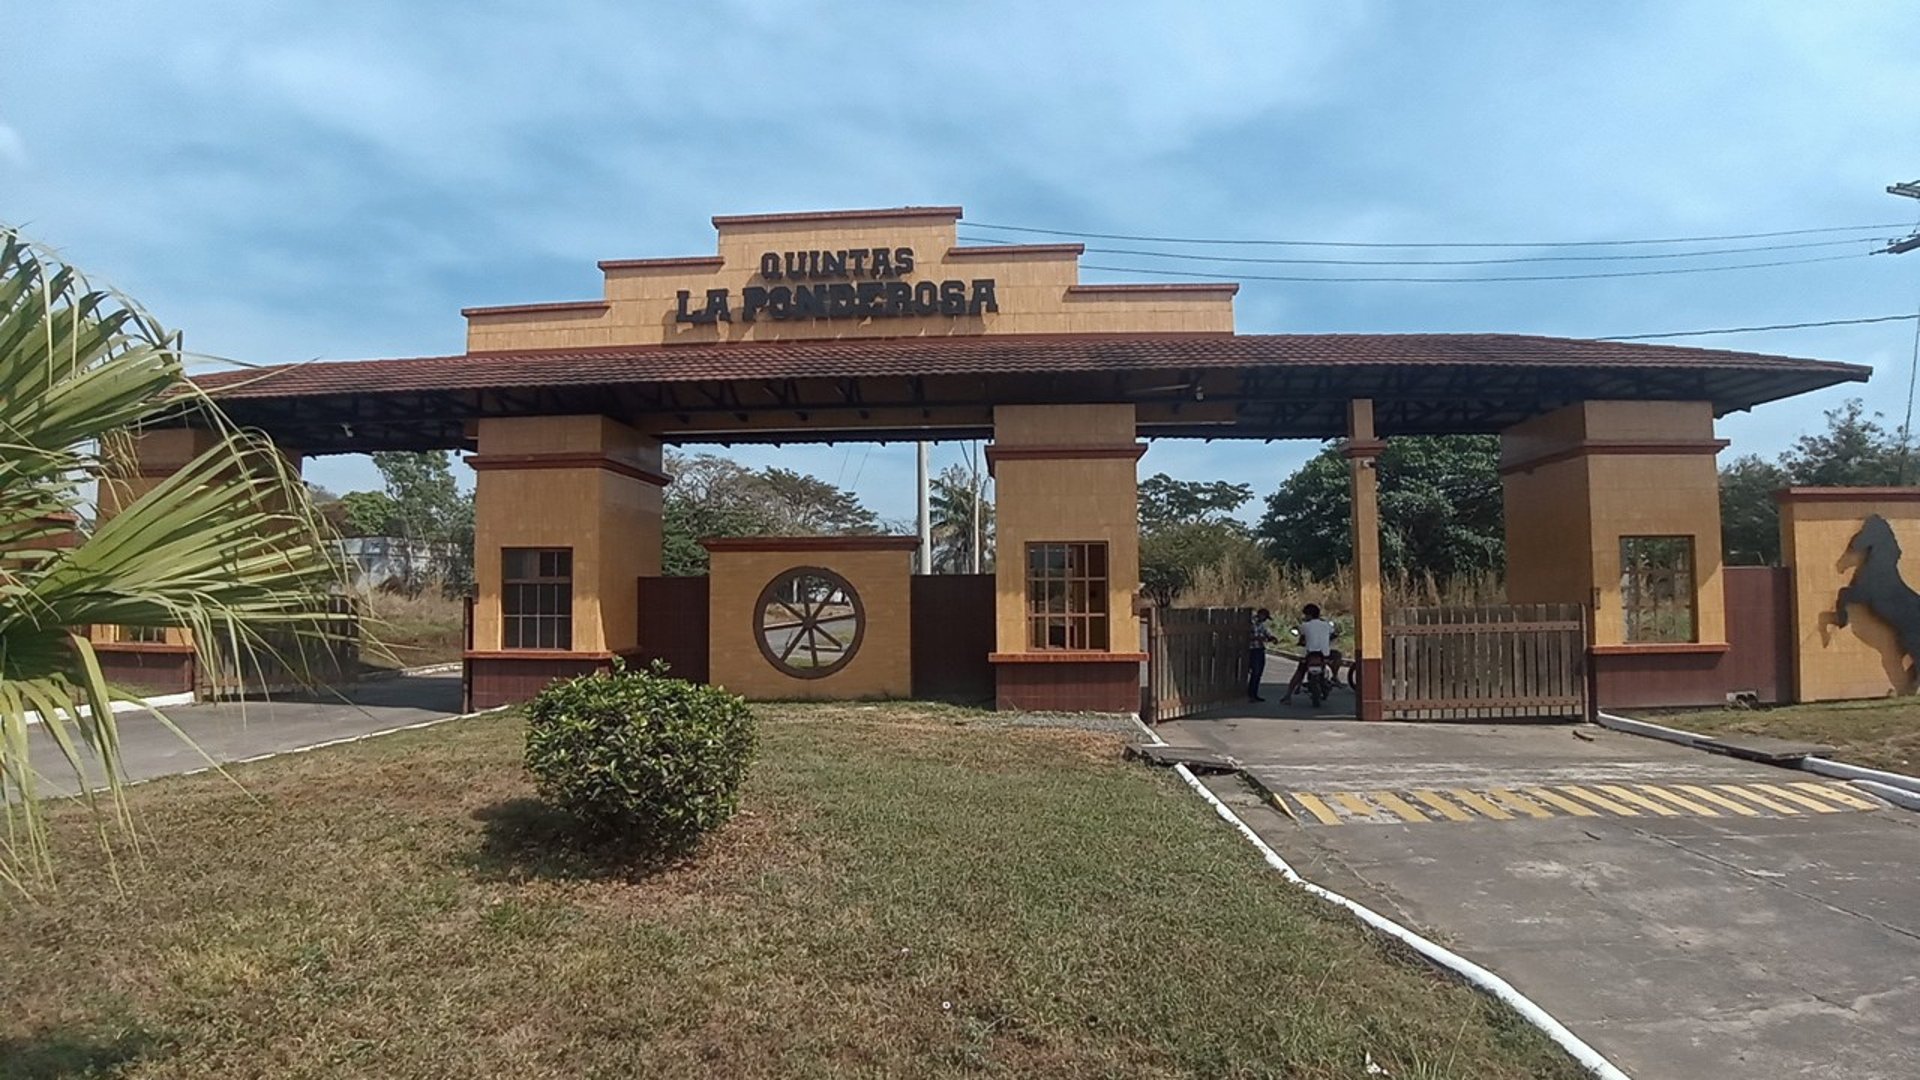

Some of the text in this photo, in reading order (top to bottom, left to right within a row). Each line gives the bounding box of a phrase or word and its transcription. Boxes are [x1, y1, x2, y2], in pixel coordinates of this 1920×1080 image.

[761, 247, 914, 280] QUINTAS
[676, 279, 999, 324] LA PONDEROSA
